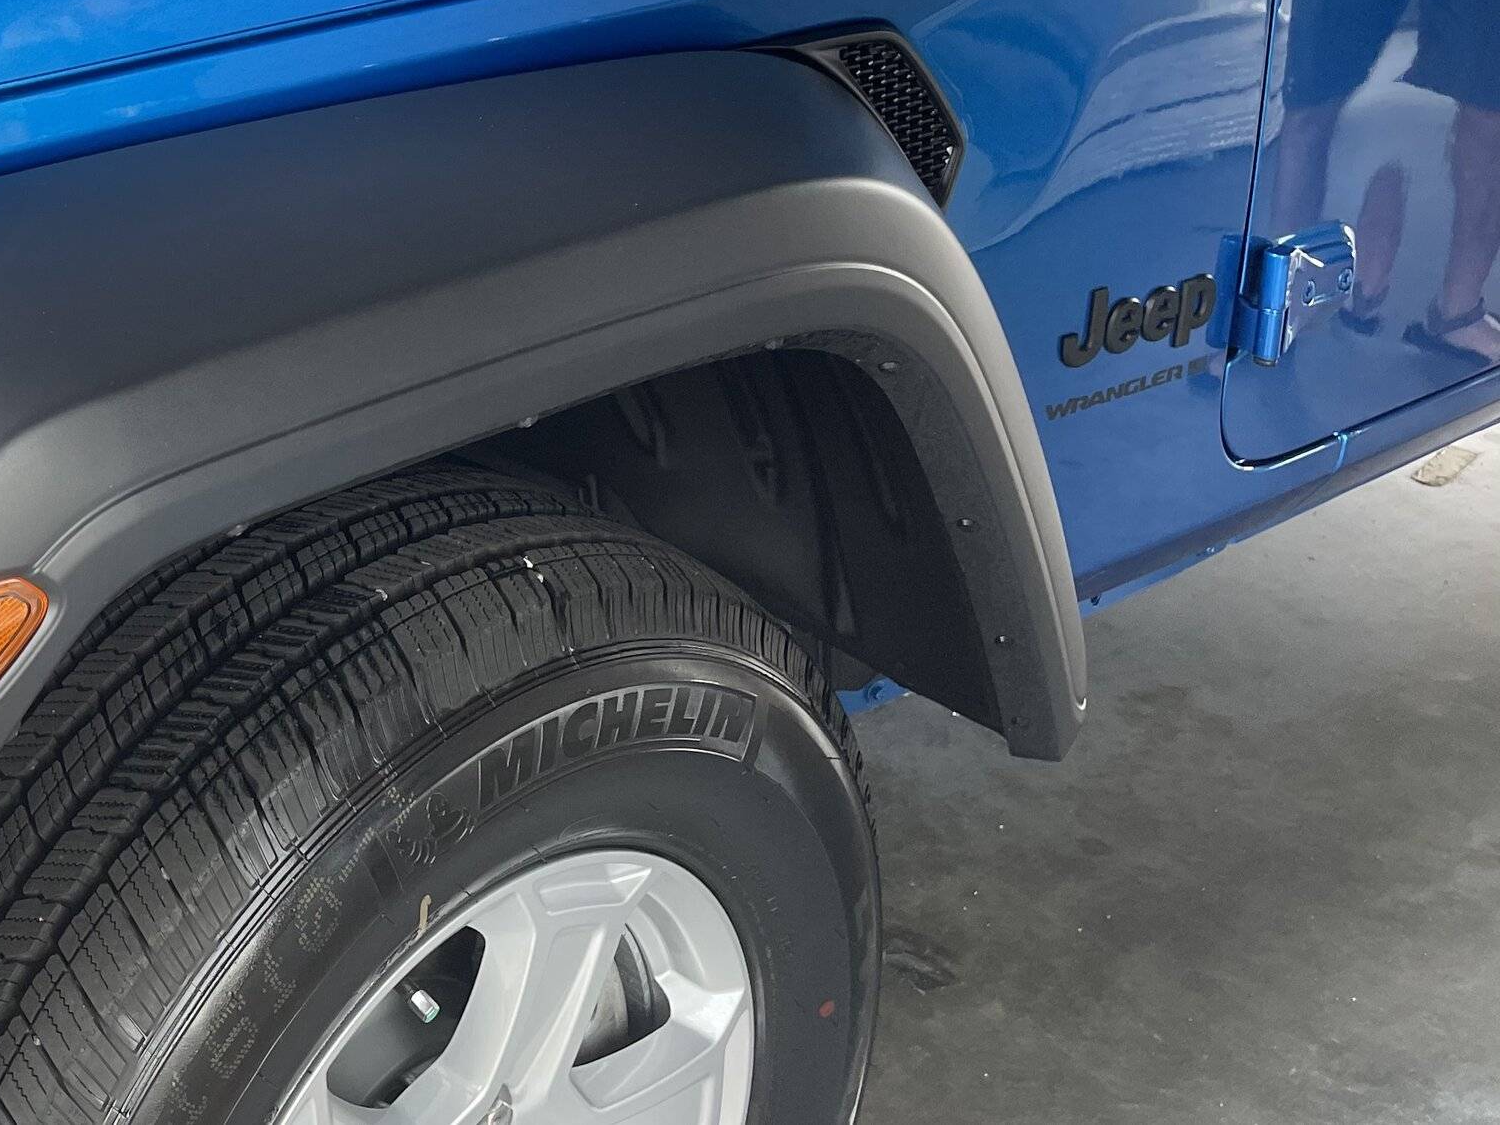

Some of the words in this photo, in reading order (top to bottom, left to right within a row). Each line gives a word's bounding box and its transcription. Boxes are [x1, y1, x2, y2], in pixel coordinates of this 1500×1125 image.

[1059, 273, 1216, 368] Jeep
[1045, 364, 1183, 421] WRANGLER
[477, 686, 754, 812] MICHELIN
